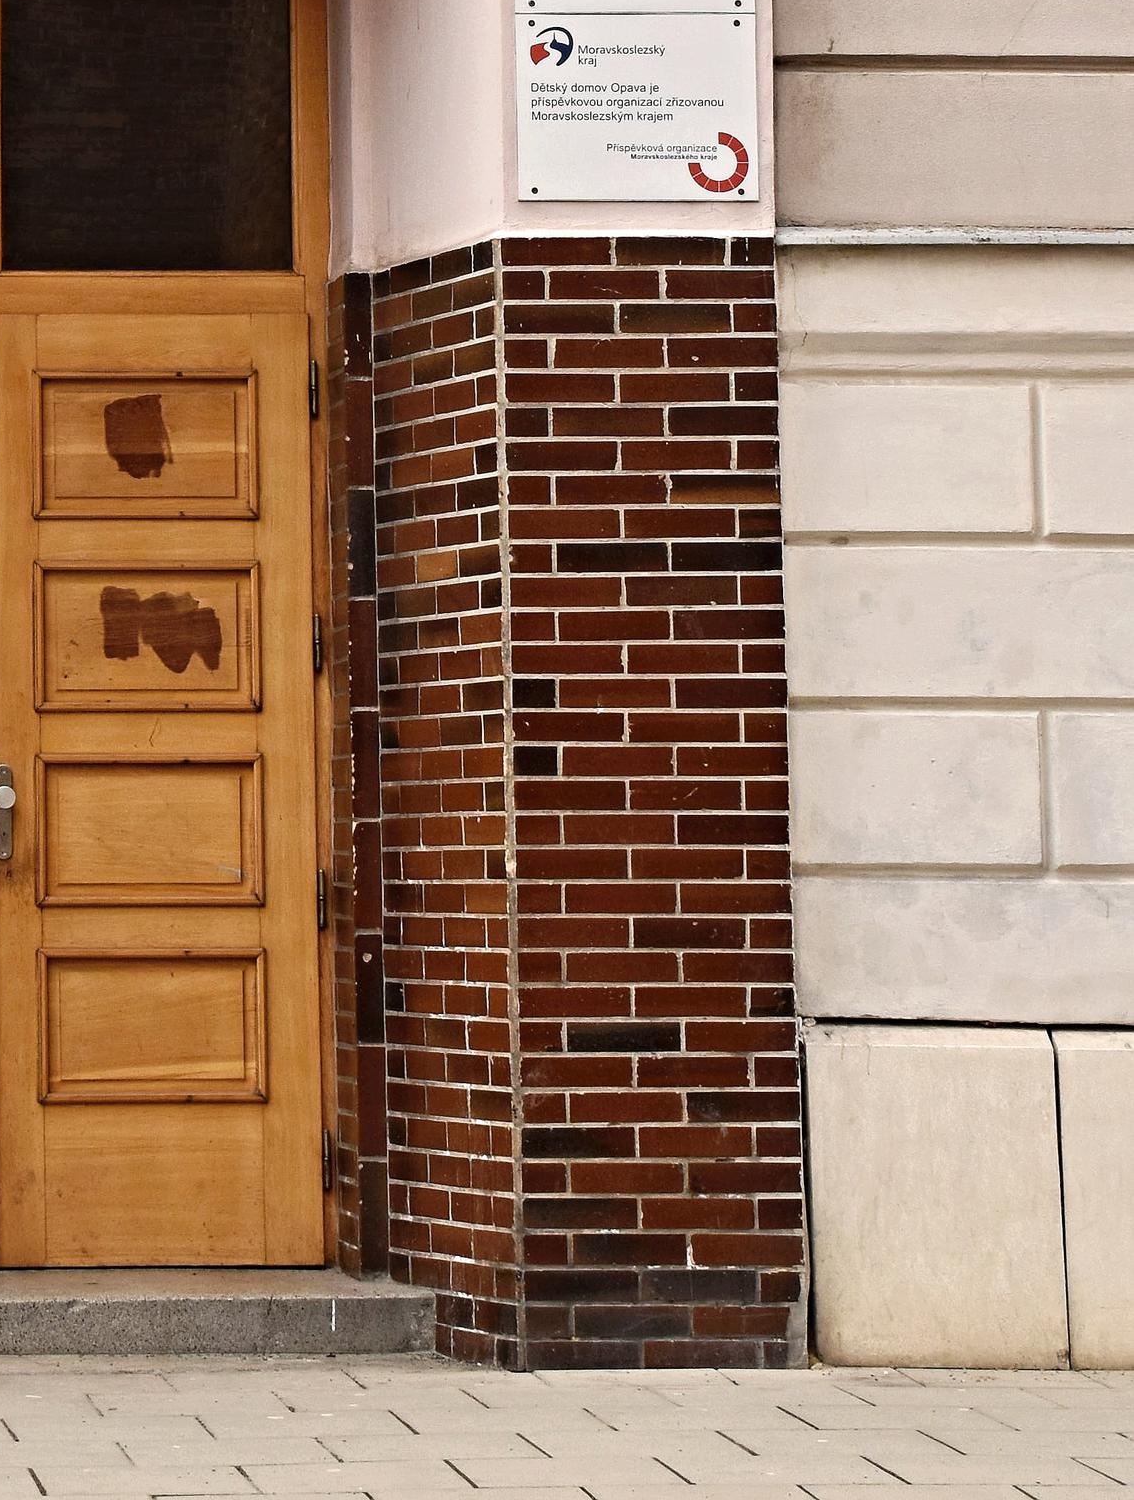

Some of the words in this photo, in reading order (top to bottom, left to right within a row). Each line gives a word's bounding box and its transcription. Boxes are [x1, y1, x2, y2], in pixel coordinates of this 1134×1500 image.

[577, 44, 666, 56] Moravskoslezský
[577, 55, 598, 67] kraj
[530, 82, 568, 95] Dětský
[570, 82, 608, 93] domov
[610, 82, 647, 95] Opava
[649, 83, 660, 95] je
[531, 96, 603, 109] příspěvkovou
[605, 96, 662, 110] organizací
[665, 96, 724, 108] zřizovanou
[531, 110, 634, 124] Moravskoslezským
[636, 110, 674, 124] krajem
[606, 143, 664, 154] Příspěvková
[666, 144, 718, 154] organizace
[700, 153, 718, 161] kraje
